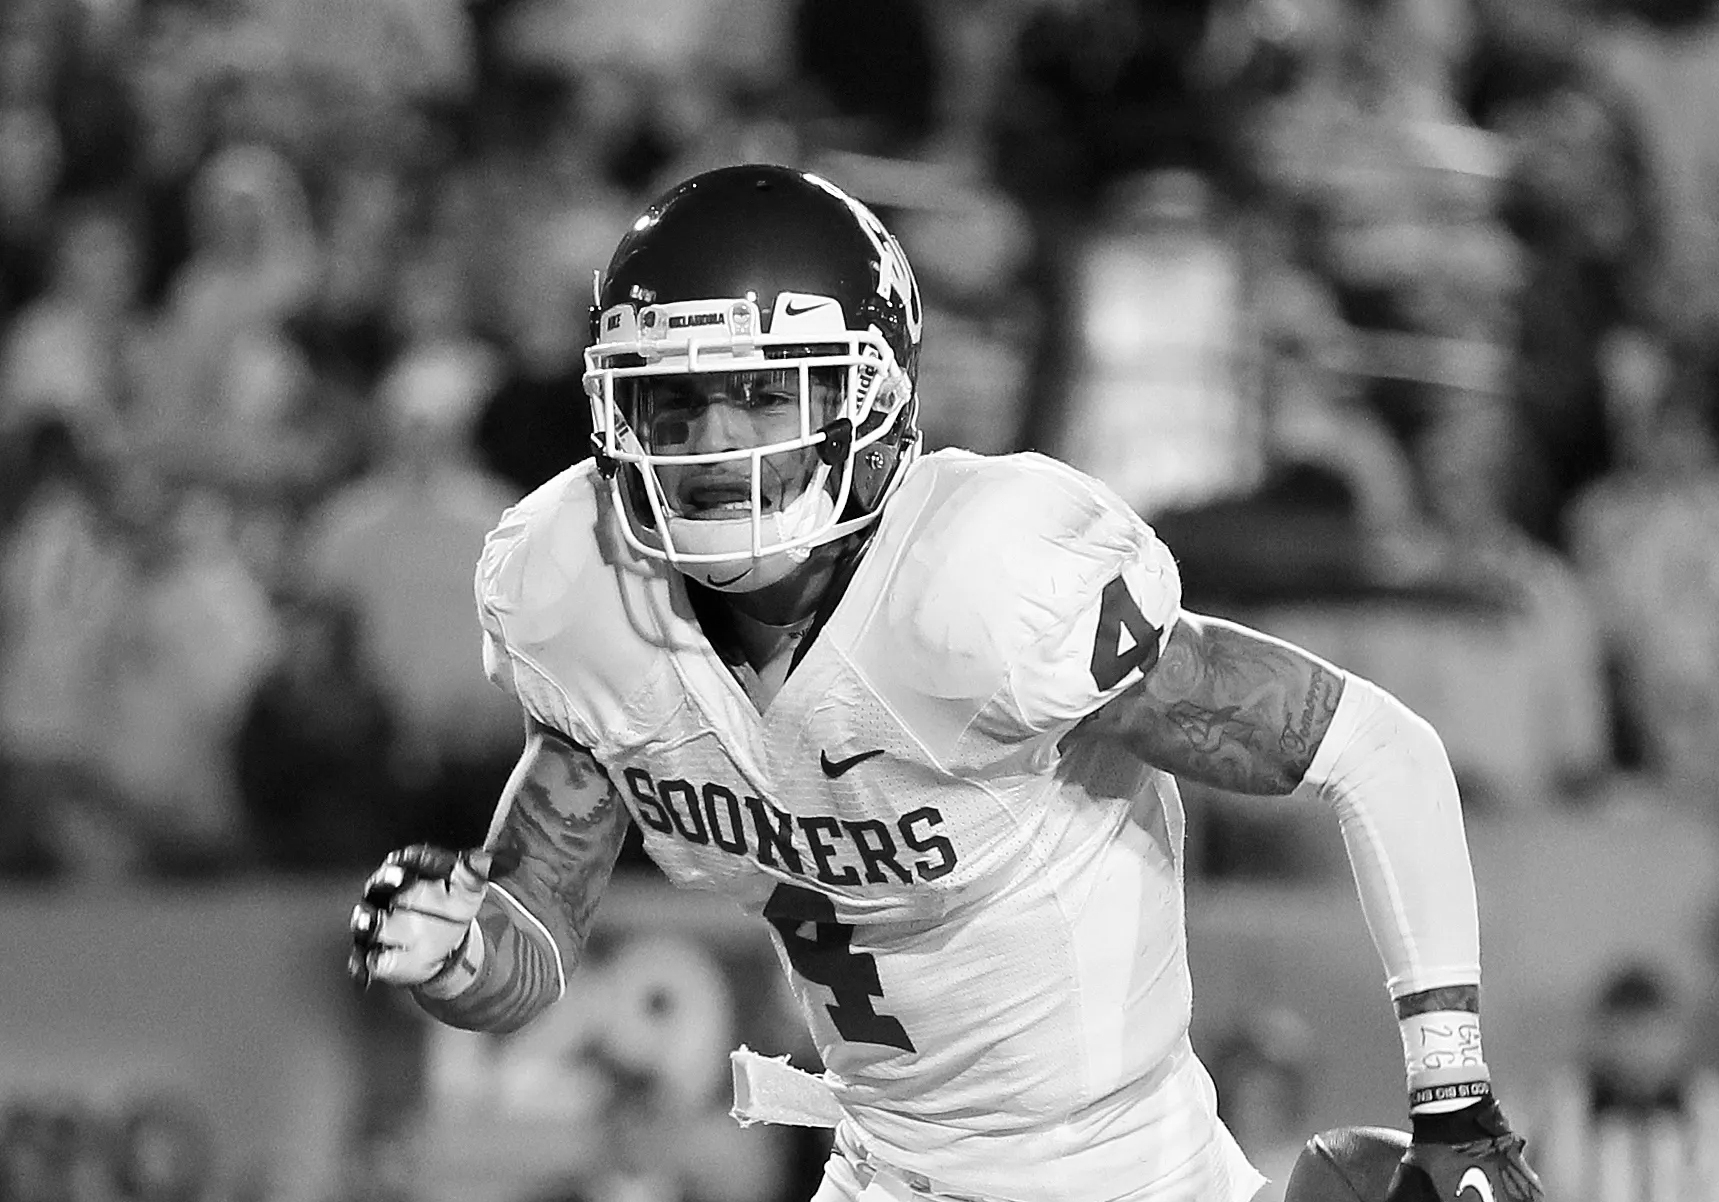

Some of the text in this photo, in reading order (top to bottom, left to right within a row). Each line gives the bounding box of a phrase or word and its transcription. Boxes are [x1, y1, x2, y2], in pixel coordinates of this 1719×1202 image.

[1090, 573, 1164, 692] 4
[622, 766, 960, 888] SOONERS
[762, 881, 917, 1054] 4
